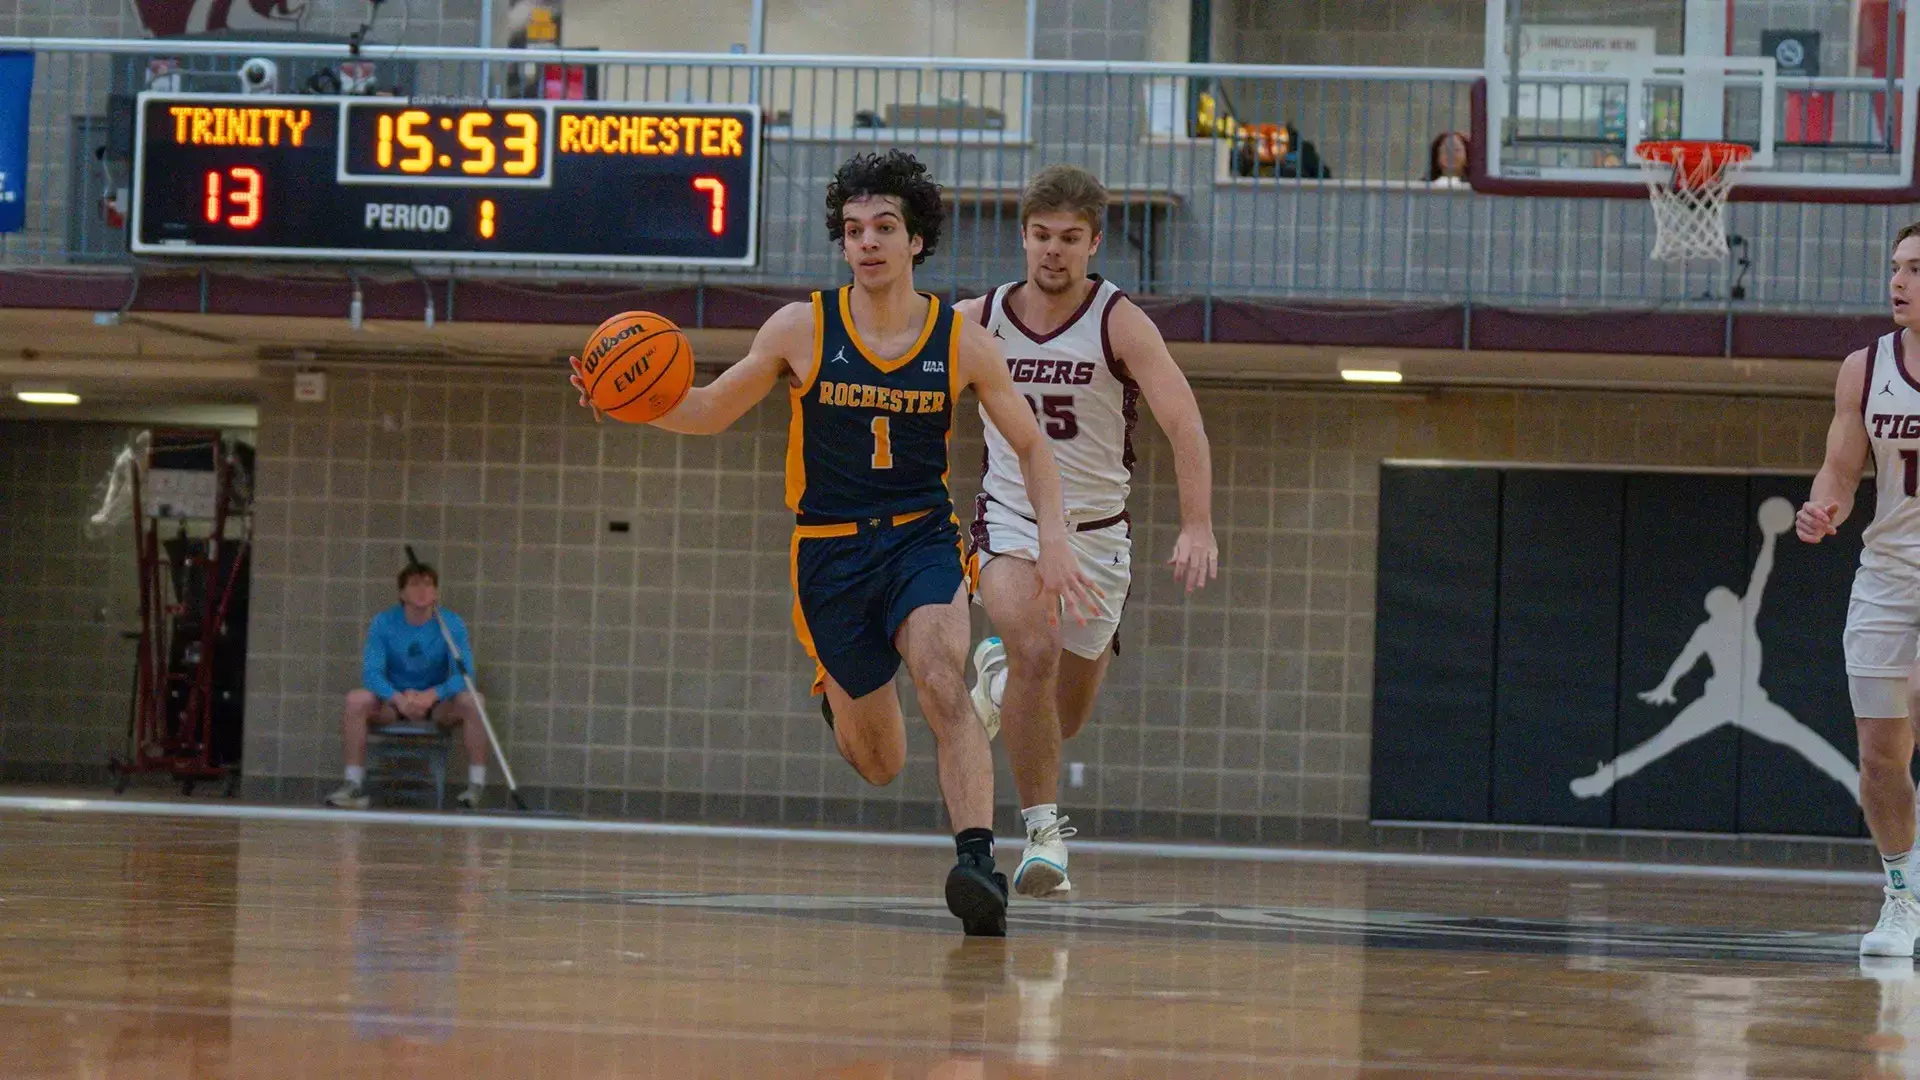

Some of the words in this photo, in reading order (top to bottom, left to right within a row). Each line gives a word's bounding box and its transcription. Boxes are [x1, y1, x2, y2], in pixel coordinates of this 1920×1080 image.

[170, 106, 311, 146] TRINITY
[377, 111, 538, 175] 15:53
[559, 115, 743, 156] ROCHESTER
[205, 166, 263, 229] 13
[365, 203, 451, 231] PERIOD
[693, 177, 725, 234] 7
[479, 199, 495, 239] 1
[585, 324, 646, 374] Wilson
[923, 360, 945, 372] UAA
[819, 381, 945, 413] ROCHESTER
[871, 416, 893, 469] 1
